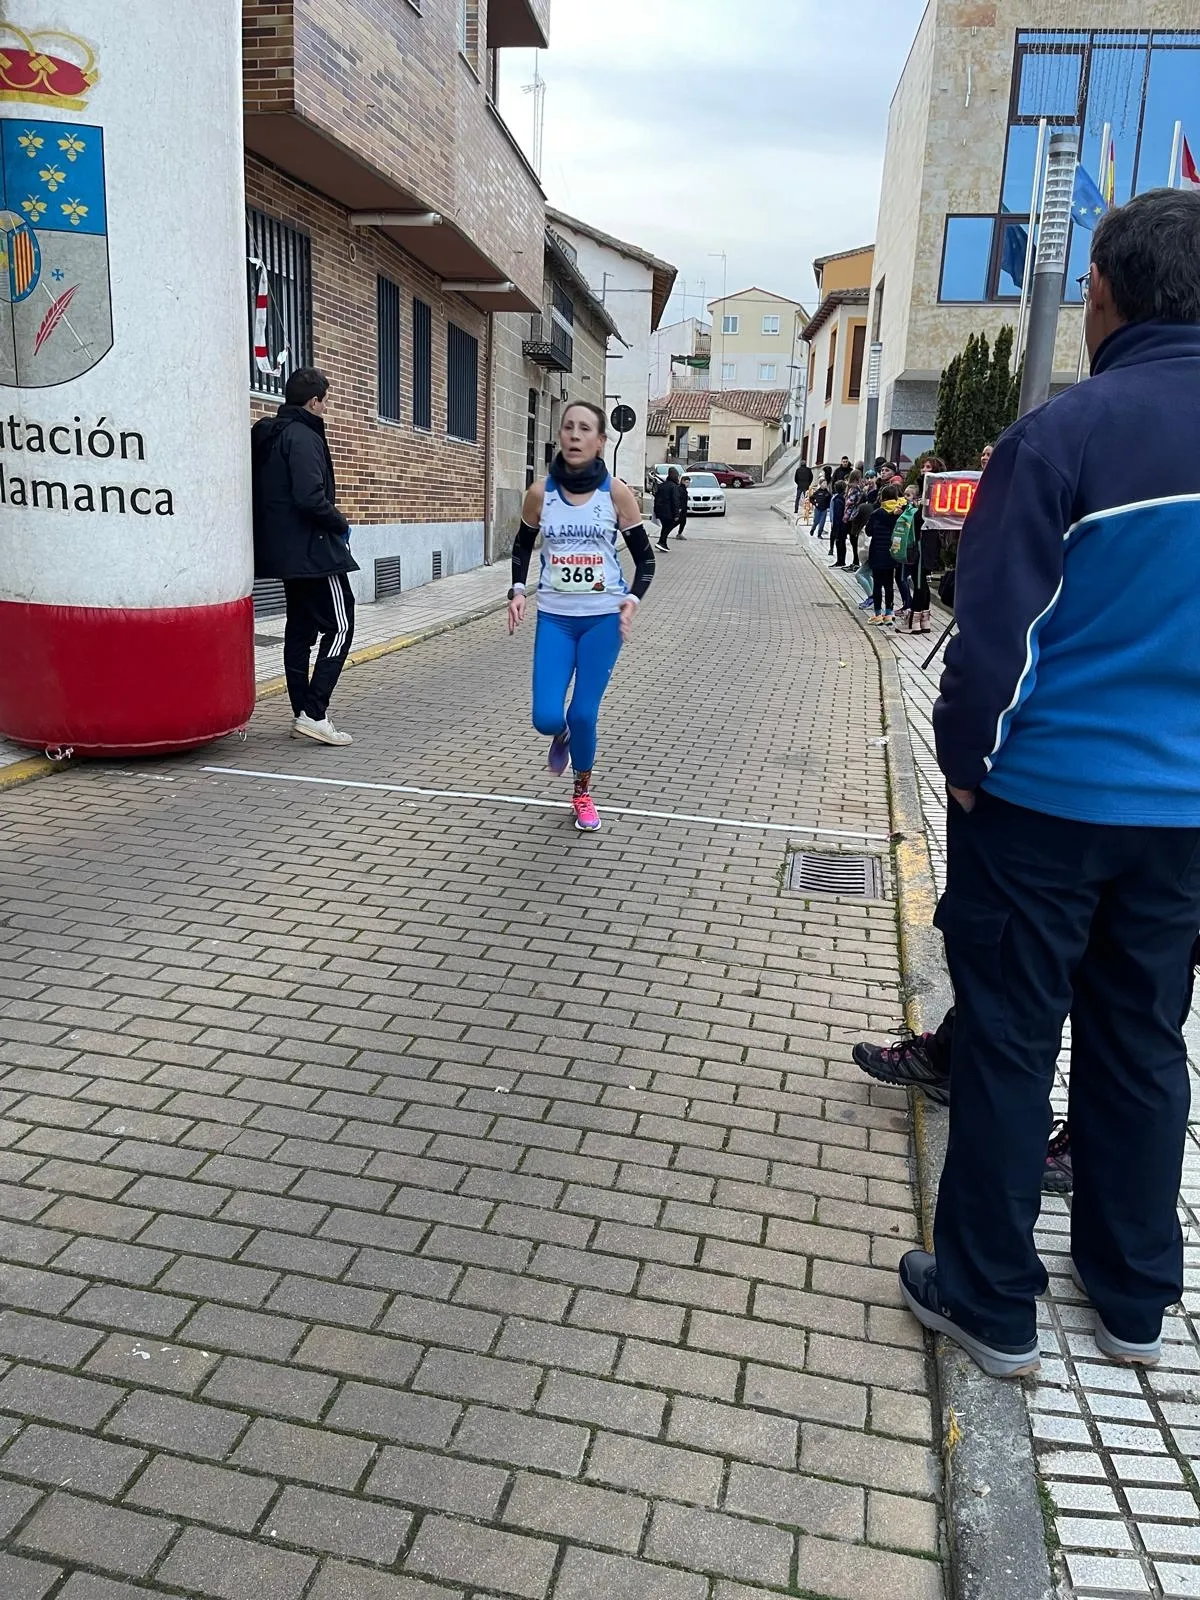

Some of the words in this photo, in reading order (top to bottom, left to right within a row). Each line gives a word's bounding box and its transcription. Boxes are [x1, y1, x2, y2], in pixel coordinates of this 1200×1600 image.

[544, 525, 556, 538] LA
[551, 554, 603, 565] bedunia
[561, 567, 594, 583] 368
